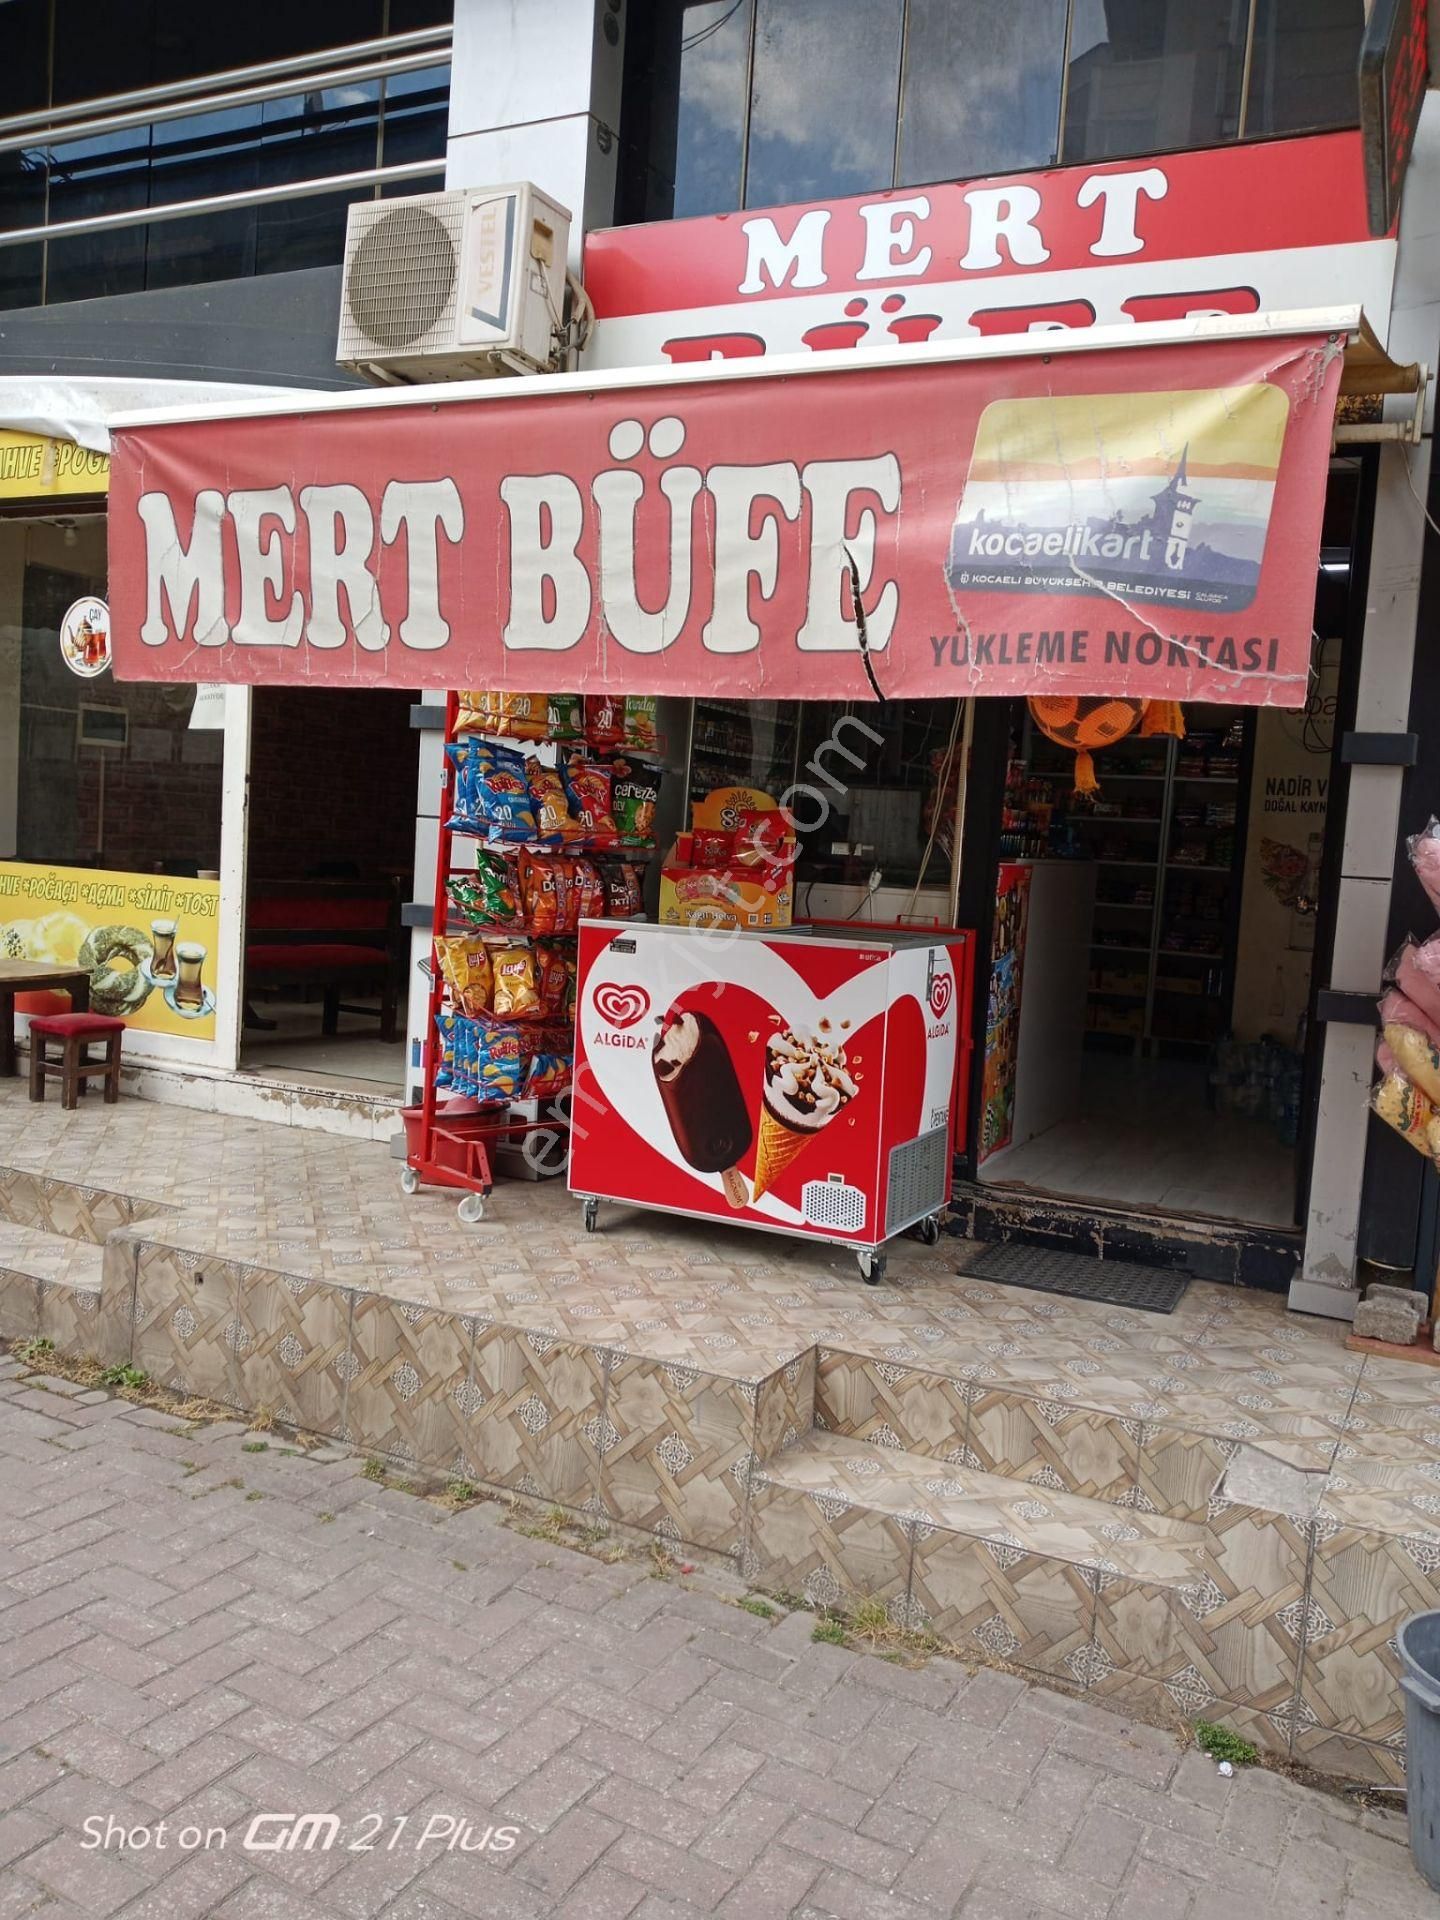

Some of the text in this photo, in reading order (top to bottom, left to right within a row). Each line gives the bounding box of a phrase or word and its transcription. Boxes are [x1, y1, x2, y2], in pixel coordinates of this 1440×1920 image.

[738, 168, 1169, 295] MERT
[0, 444, 43, 480] HVE
[138, 415, 902, 655] MERT BÜFE
[968, 526, 1152, 561] kocaelikart
[1023, 575, 1103, 589] BÜYÜKŞEHR
[930, 625, 1280, 673] YÜKLEME NOKTASI
[1265, 774, 1312, 797] NADİR
[495, 804, 512, 821] 20
[28, 872, 78, 905] POĞAÇA
[87, 883, 125, 909] AÇMA
[134, 884, 173, 912] SİMİT
[182, 892, 219, 916] TOST
